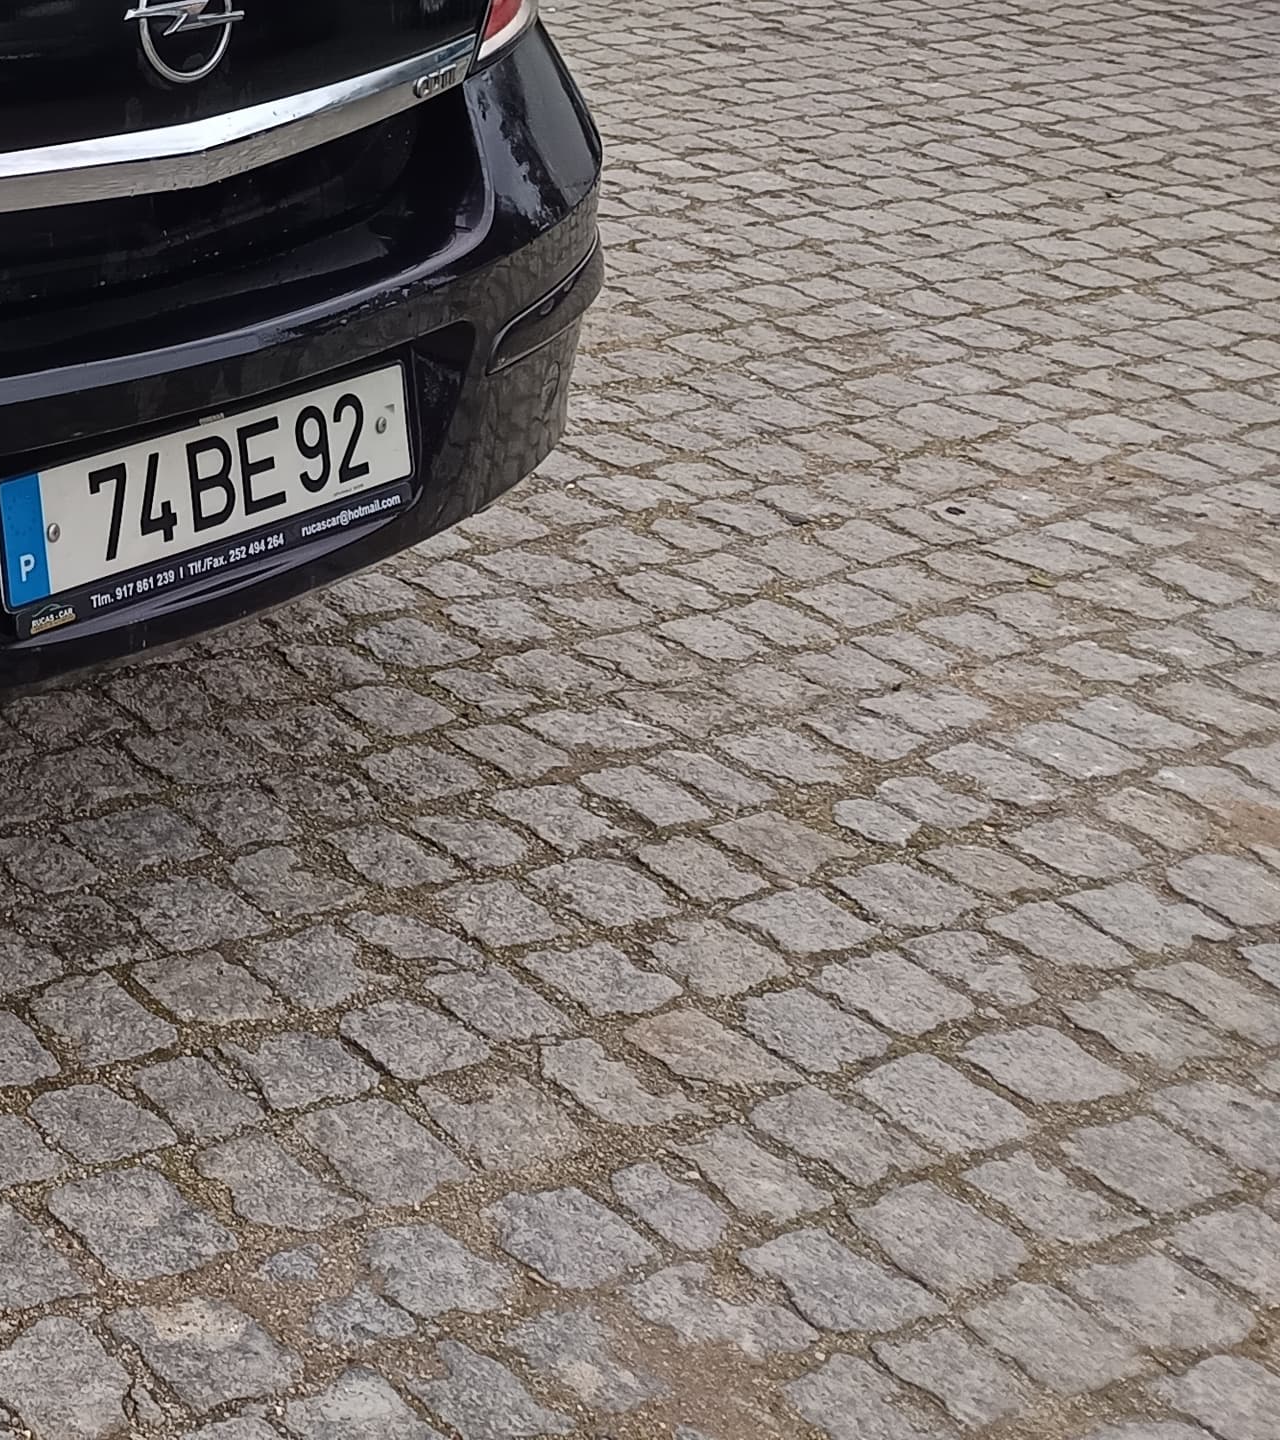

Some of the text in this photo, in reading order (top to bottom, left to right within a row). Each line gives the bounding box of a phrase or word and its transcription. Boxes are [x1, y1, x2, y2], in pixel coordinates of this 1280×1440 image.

[19, 553, 35, 582] P
[90, 593, 114, 608] Tlm.
[115, 582, 134, 600] 917
[136, 576, 154, 593] 861
[156, 569, 175, 586] 239
[228, 546, 247, 563] 252
[248, 539, 265, 555] 494
[267, 532, 284, 550] 264
[301, 494, 401, 537] rucascar@hotmail.com
